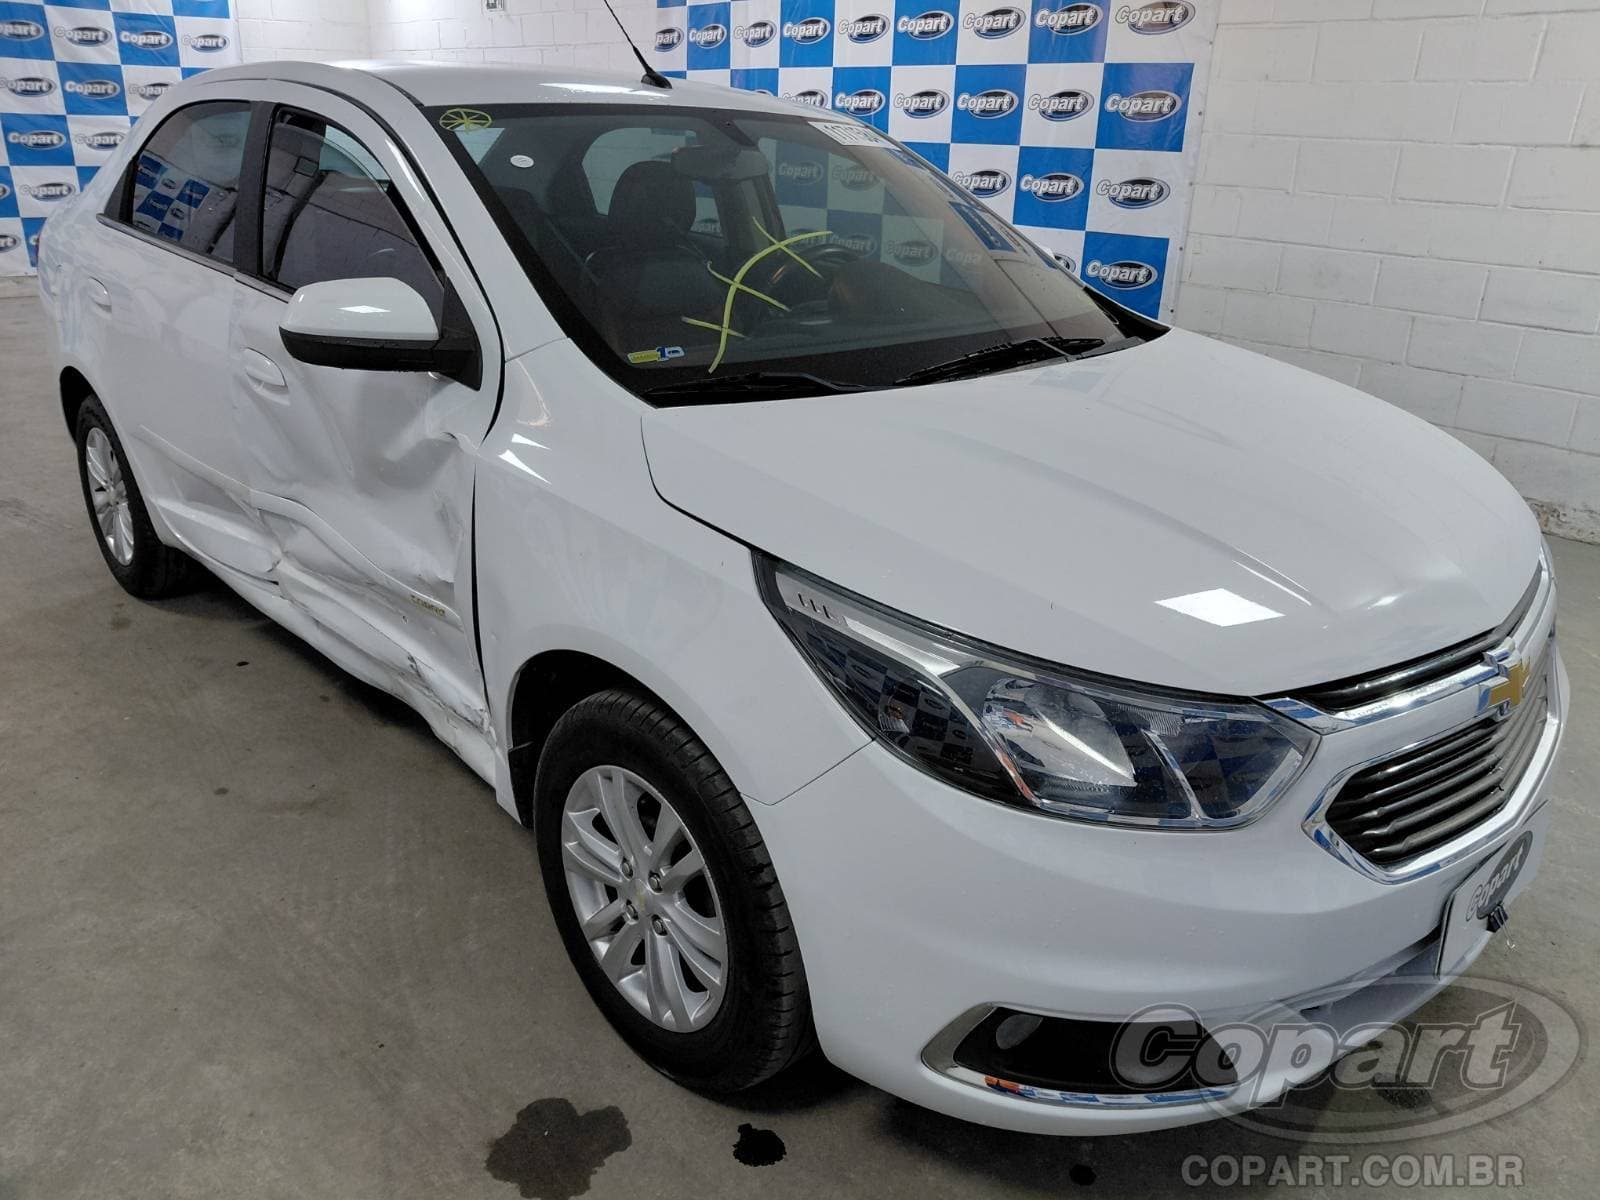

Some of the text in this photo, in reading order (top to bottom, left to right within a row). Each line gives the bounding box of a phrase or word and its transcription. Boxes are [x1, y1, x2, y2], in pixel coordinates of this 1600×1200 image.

[897, 15, 947, 35] Copart
[963, 11, 1018, 33] Copart
[1035, 7, 1096, 30] Copart
[1115, 5, 1184, 28] Copart
[54, 26, 105, 41] Copart
[689, 27, 723, 45] Copart
[734, 24, 771, 42] Copart
[783, 21, 824, 40] Copart
[838, 17, 883, 38] Copart
[120, 31, 168, 45] Copart
[183, 34, 225, 48] Copart
[64, 80, 114, 95] Copart
[129, 84, 167, 96] Copar
[836, 92, 881, 111] Copart
[895, 93, 943, 111] Copart
[957, 93, 1011, 112] Copart
[1028, 94, 1085, 113] Copart
[1105, 95, 1172, 116] Copart
[8, 132, 59, 147] Copart
[778, 162, 818, 180] Copart
[20, 184, 68, 198] Copart
[1020, 174, 1076, 195] Copart
[1096, 179, 1160, 201] Copart
[1086, 259, 1149, 283] Copart
[1466, 842, 1525, 922] Copart
